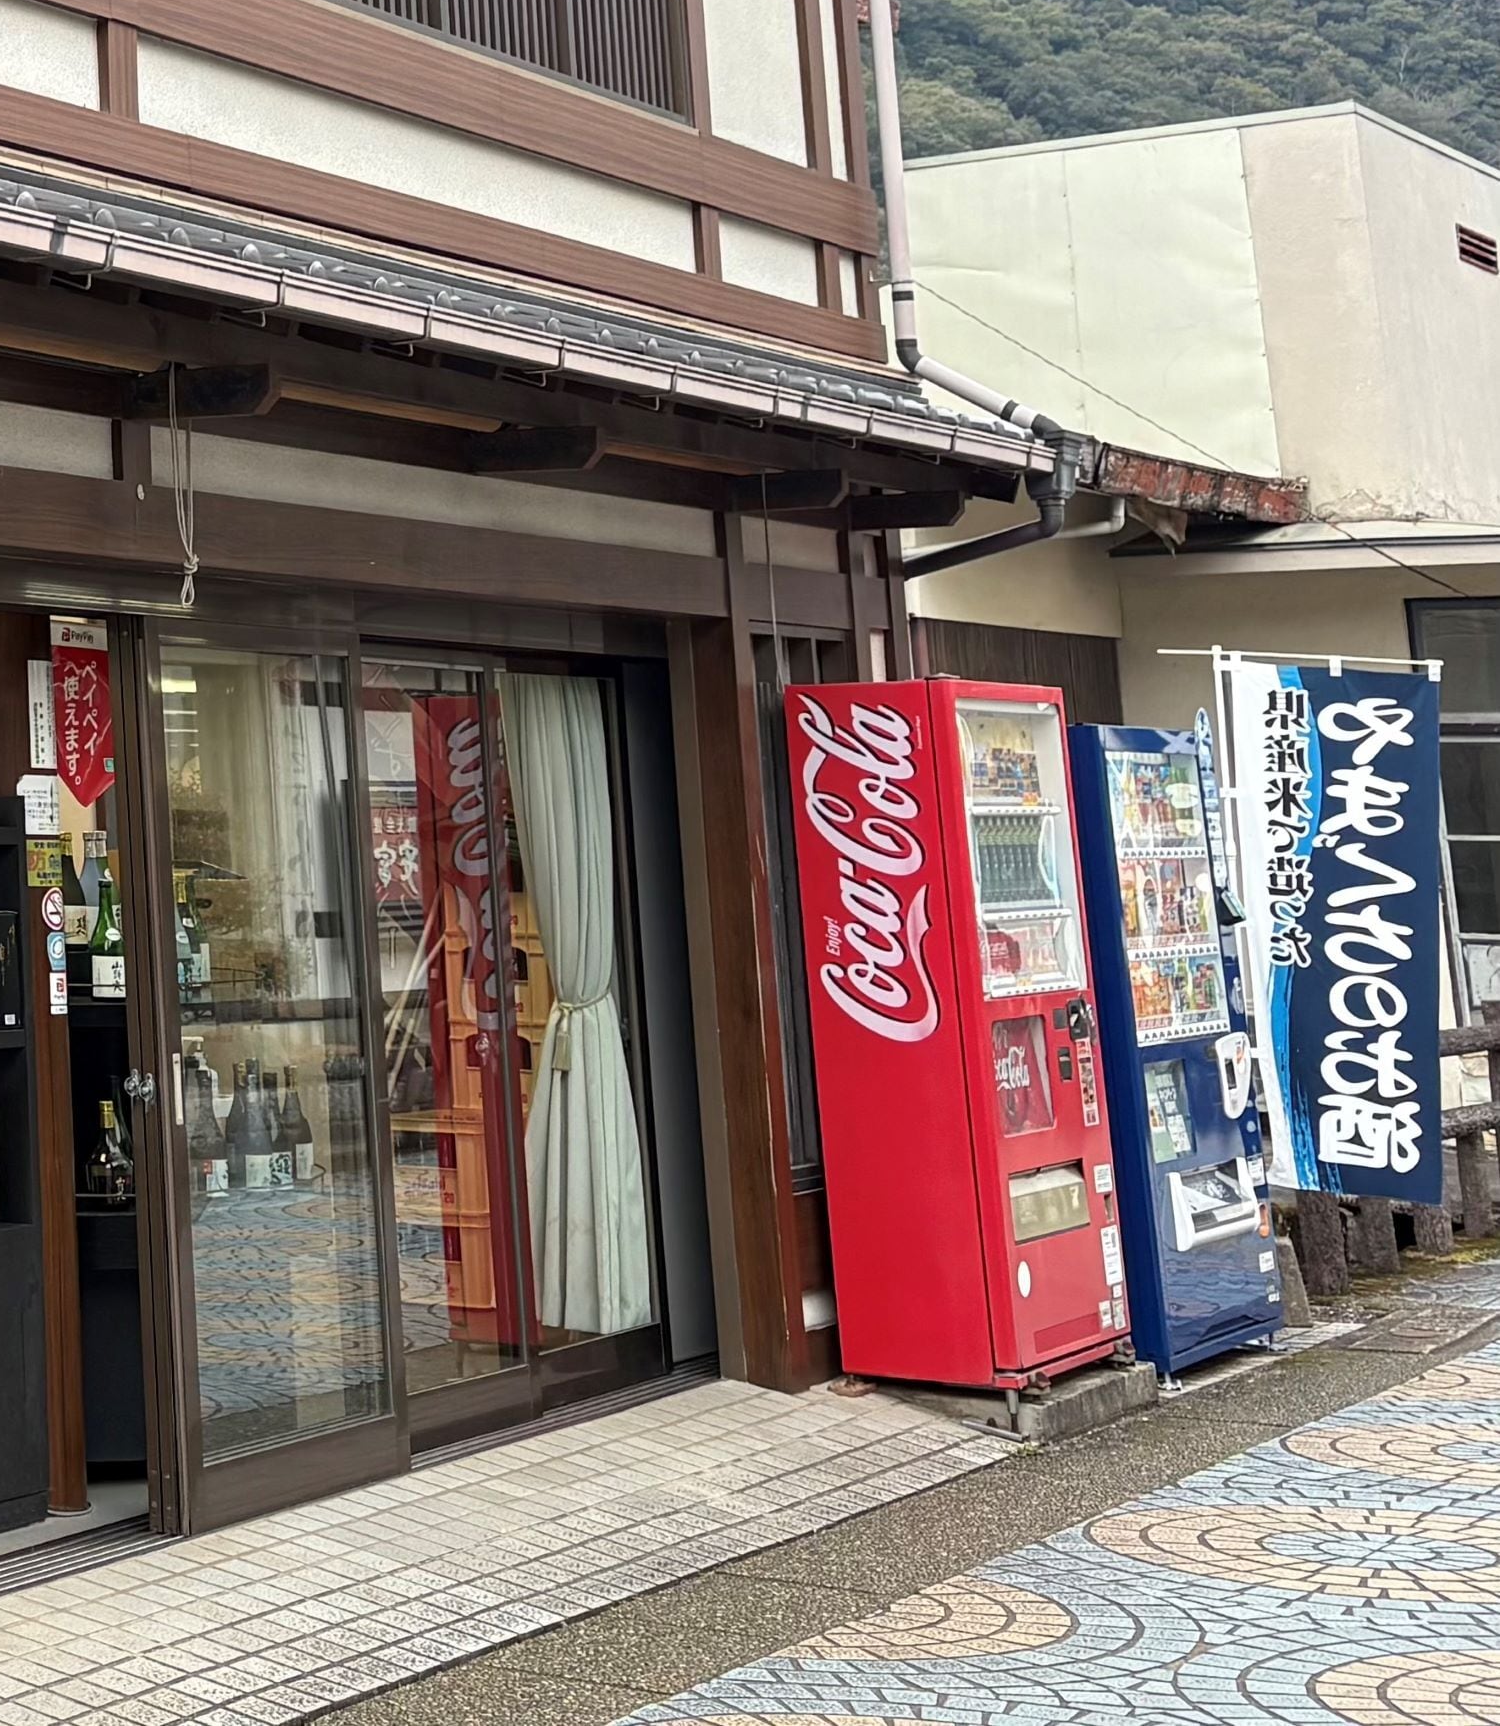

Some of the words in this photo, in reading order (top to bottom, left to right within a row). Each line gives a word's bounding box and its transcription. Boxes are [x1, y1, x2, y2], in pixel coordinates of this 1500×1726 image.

[63, 661, 82, 785] へ使えます。
[82, 661, 98, 756] ペイペイ
[798, 693, 940, 1042] Coca-Cola
[825, 915, 841, 958] Enjoy!
